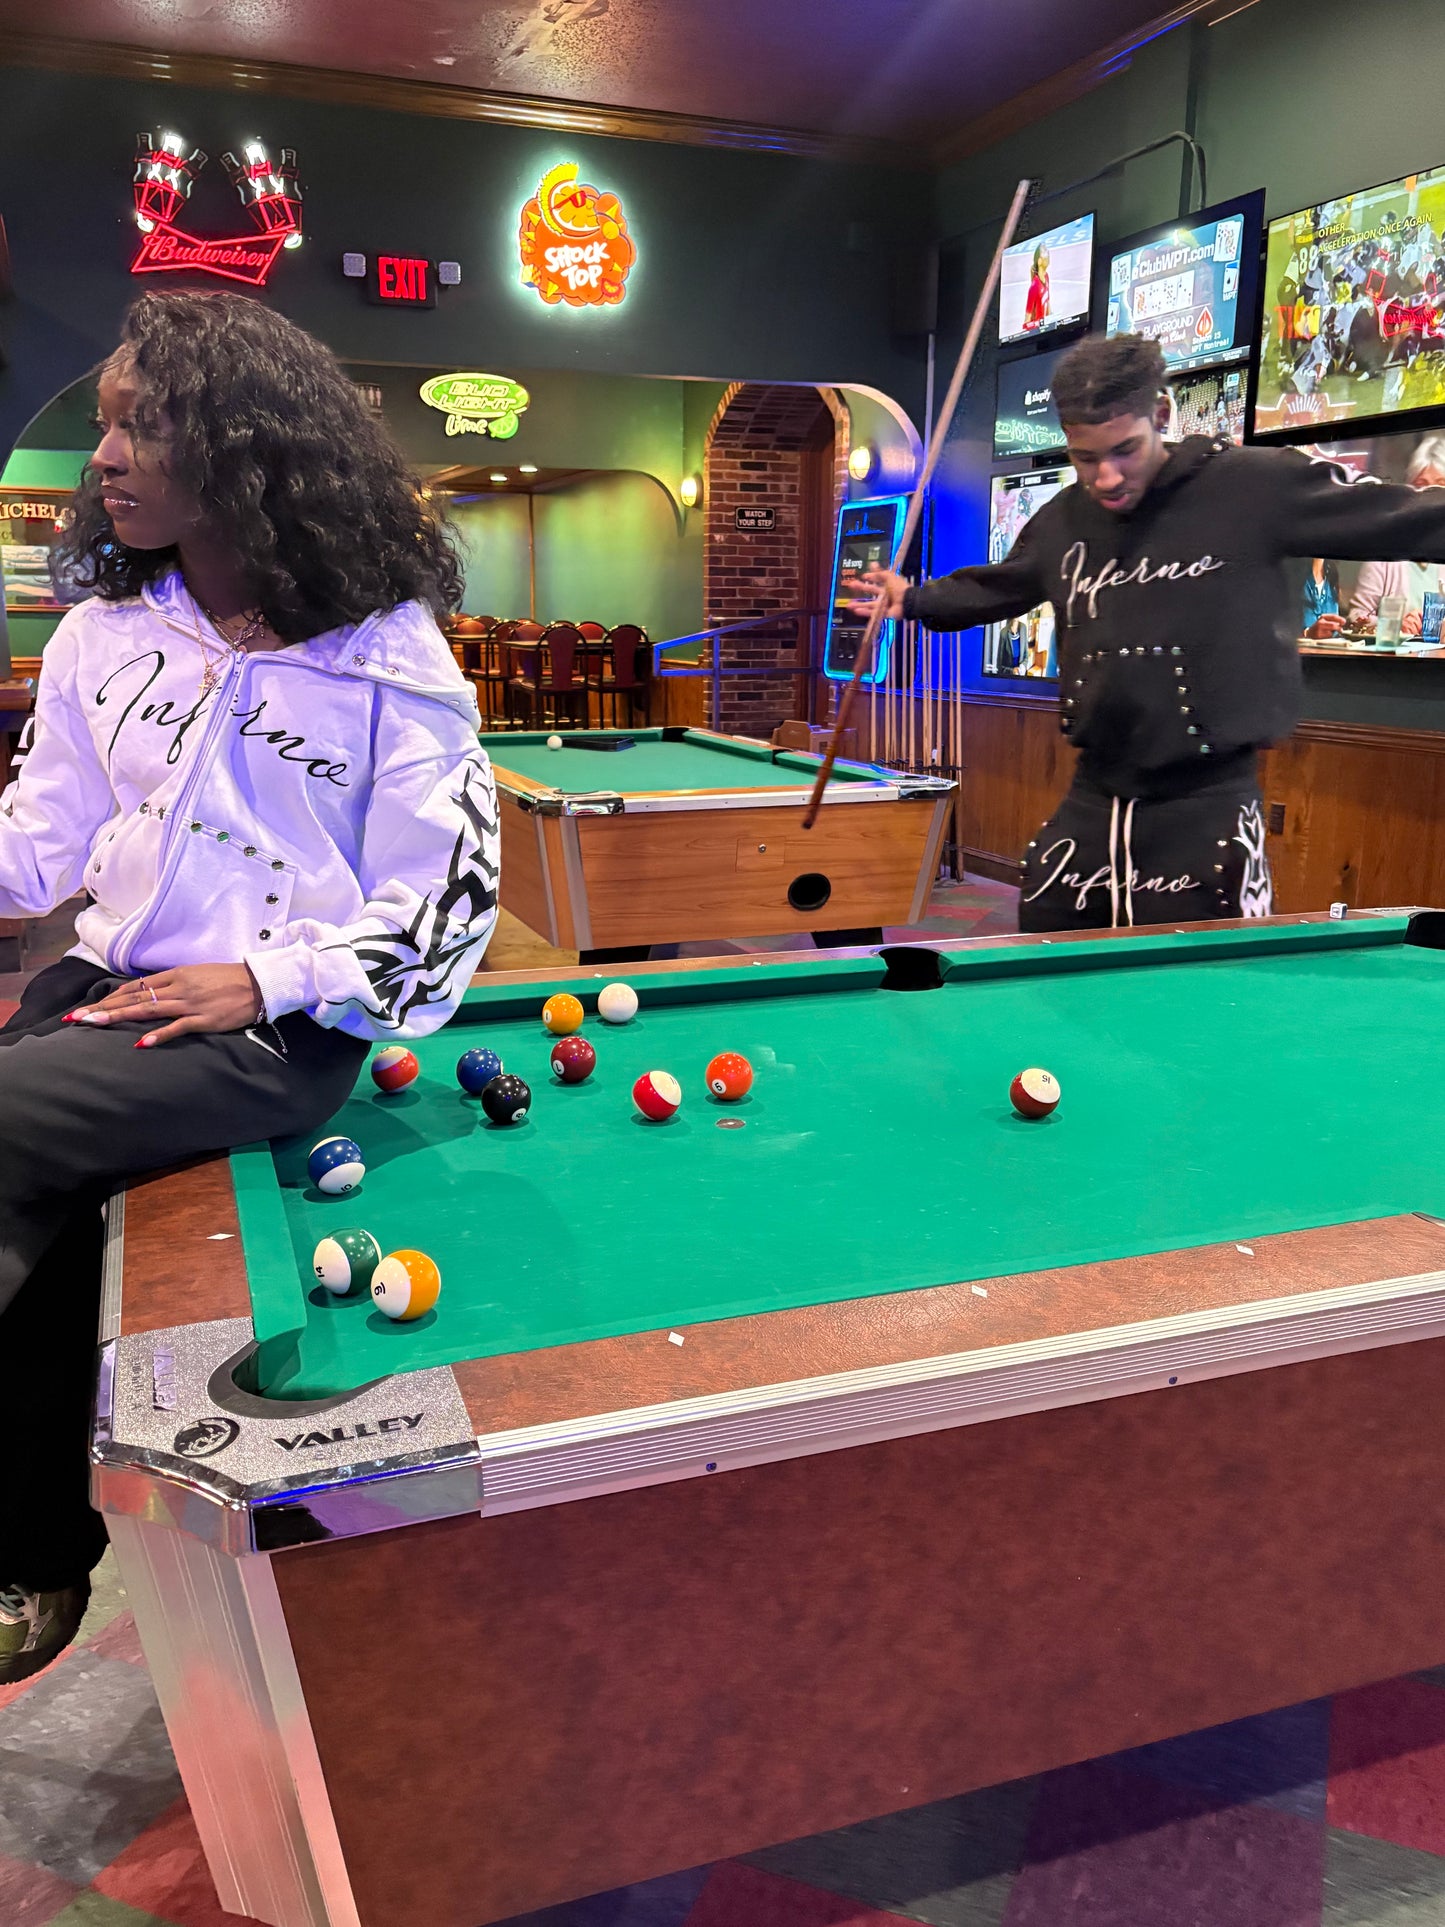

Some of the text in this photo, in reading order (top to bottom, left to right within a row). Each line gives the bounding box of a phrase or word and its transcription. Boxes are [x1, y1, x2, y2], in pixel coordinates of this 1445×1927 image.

[1319, 229, 1376, 253] ACCELERATION
[1378, 219, 1401, 236] ONCE
[143, 235, 271, 267] Budweiser
[544, 241, 610, 273] SHOCK
[1138, 244, 1215, 278] ClubWPT.com
[1300, 245, 1319, 275] 88
[378, 257, 428, 300] EXIT
[561, 264, 603, 290] TOP
[1143, 315, 1194, 338] PLAYGROUND
[440, 394, 516, 410] LIGHT
[449, 381, 509, 397] BUD
[445, 414, 488, 436] Lime
[744, 510, 766, 518] WATCH
[757, 519, 773, 527] STEP
[1060, 541, 1225, 628] Inferno
[714, 1082, 723, 1092] 5
[315, 1266, 325, 1278] 14
[273, 1412, 424, 1450] VALLEY
